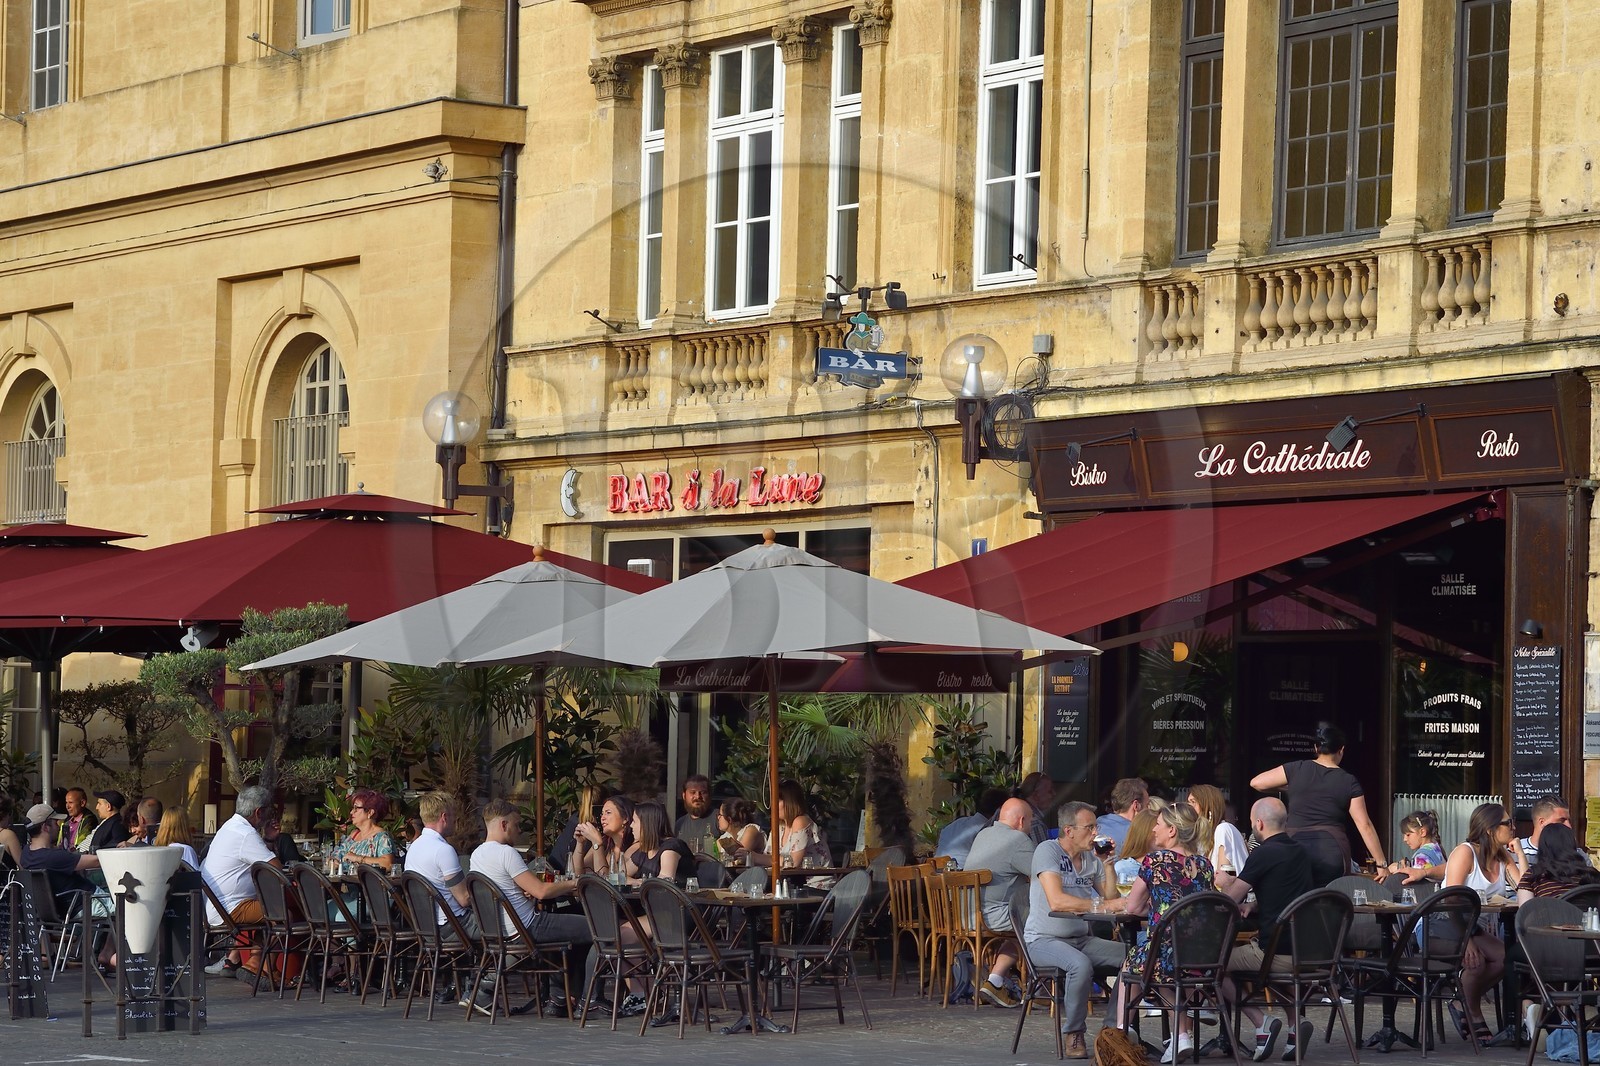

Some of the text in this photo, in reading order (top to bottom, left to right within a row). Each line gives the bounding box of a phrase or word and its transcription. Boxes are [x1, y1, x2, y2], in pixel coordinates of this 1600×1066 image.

[828, 355, 898, 373] BAR
[1476, 429, 1520, 458] Resto
[1194, 439, 1372, 478] La Cathédrale
[1069, 461, 1107, 486] Bistro
[607, 471, 673, 512] BAR
[709, 468, 742, 508] la
[747, 466, 823, 506] Lune
[1440, 573, 1465, 583] SALLE
[1431, 582, 1477, 596] CLIMATISÉE
[673, 664, 751, 688] La Cathédrale
[936, 670, 993, 688] Bistro resto
[1151, 692, 1207, 711] VINS ET SPIRITUEUX
[1423, 692, 1482, 710] PRODUITS FRAIS
[1152, 718, 1205, 730] BIÈRES PRESSION
[1424, 722, 1480, 734] FRITES MAISON
